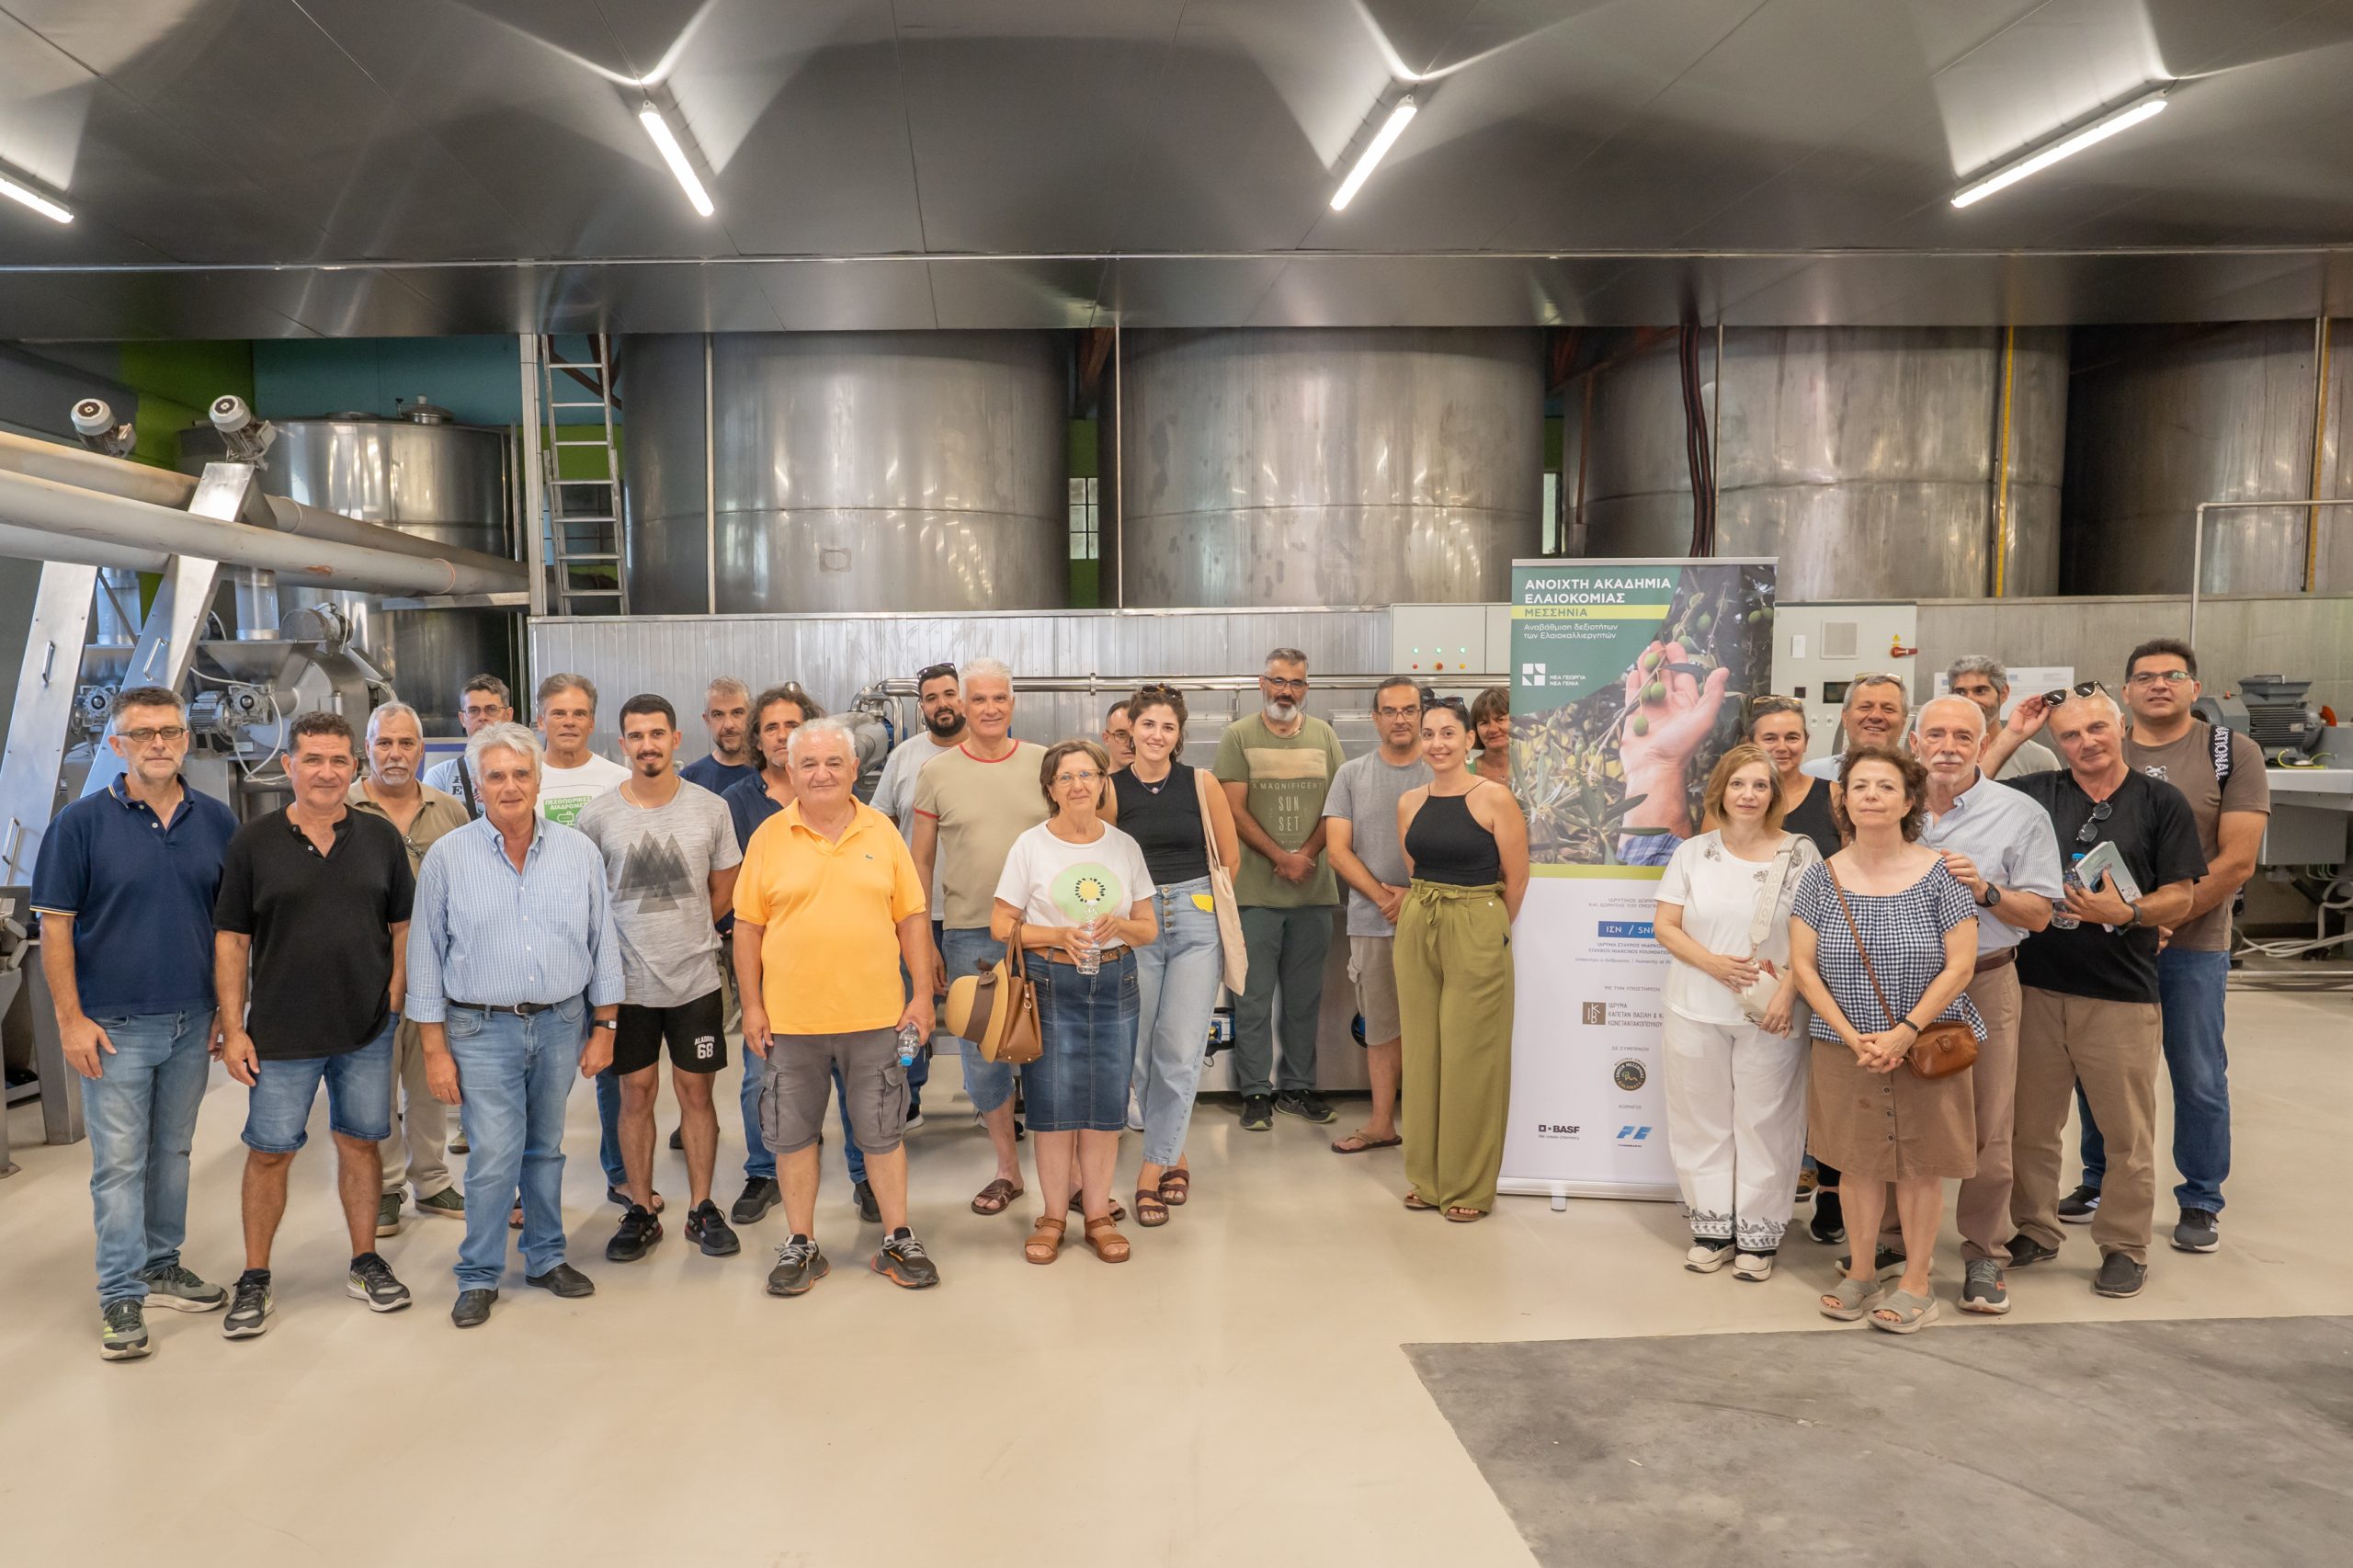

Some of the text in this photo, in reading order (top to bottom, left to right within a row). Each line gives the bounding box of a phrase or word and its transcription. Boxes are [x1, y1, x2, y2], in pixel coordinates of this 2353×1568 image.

[1524, 578, 1671, 590] ΑΝΟΙΧΤΗ ΑΚΑΔΗΜΙΑ
[1525, 593, 1625, 604] ΕΛΑΙΟΚΟΜΙΑΣ
[1524, 608, 1588, 618] ΜΕΣΣΗΝΙΑ
[1524, 622, 1618, 631] Αναβάθμιση δεξιοτήτων
[1540, 631, 1617, 641] Ελαιοκαλλιεργητών
[1260, 781, 1322, 790] MAGNIFICENT
[1279, 795, 1299, 812] SUN
[1279, 816, 1299, 832] SET
[1606, 926, 1622, 934] ΙΣΝ
[697, 1042, 714, 1059] 68
[1552, 1125, 1580, 1134] BASF
